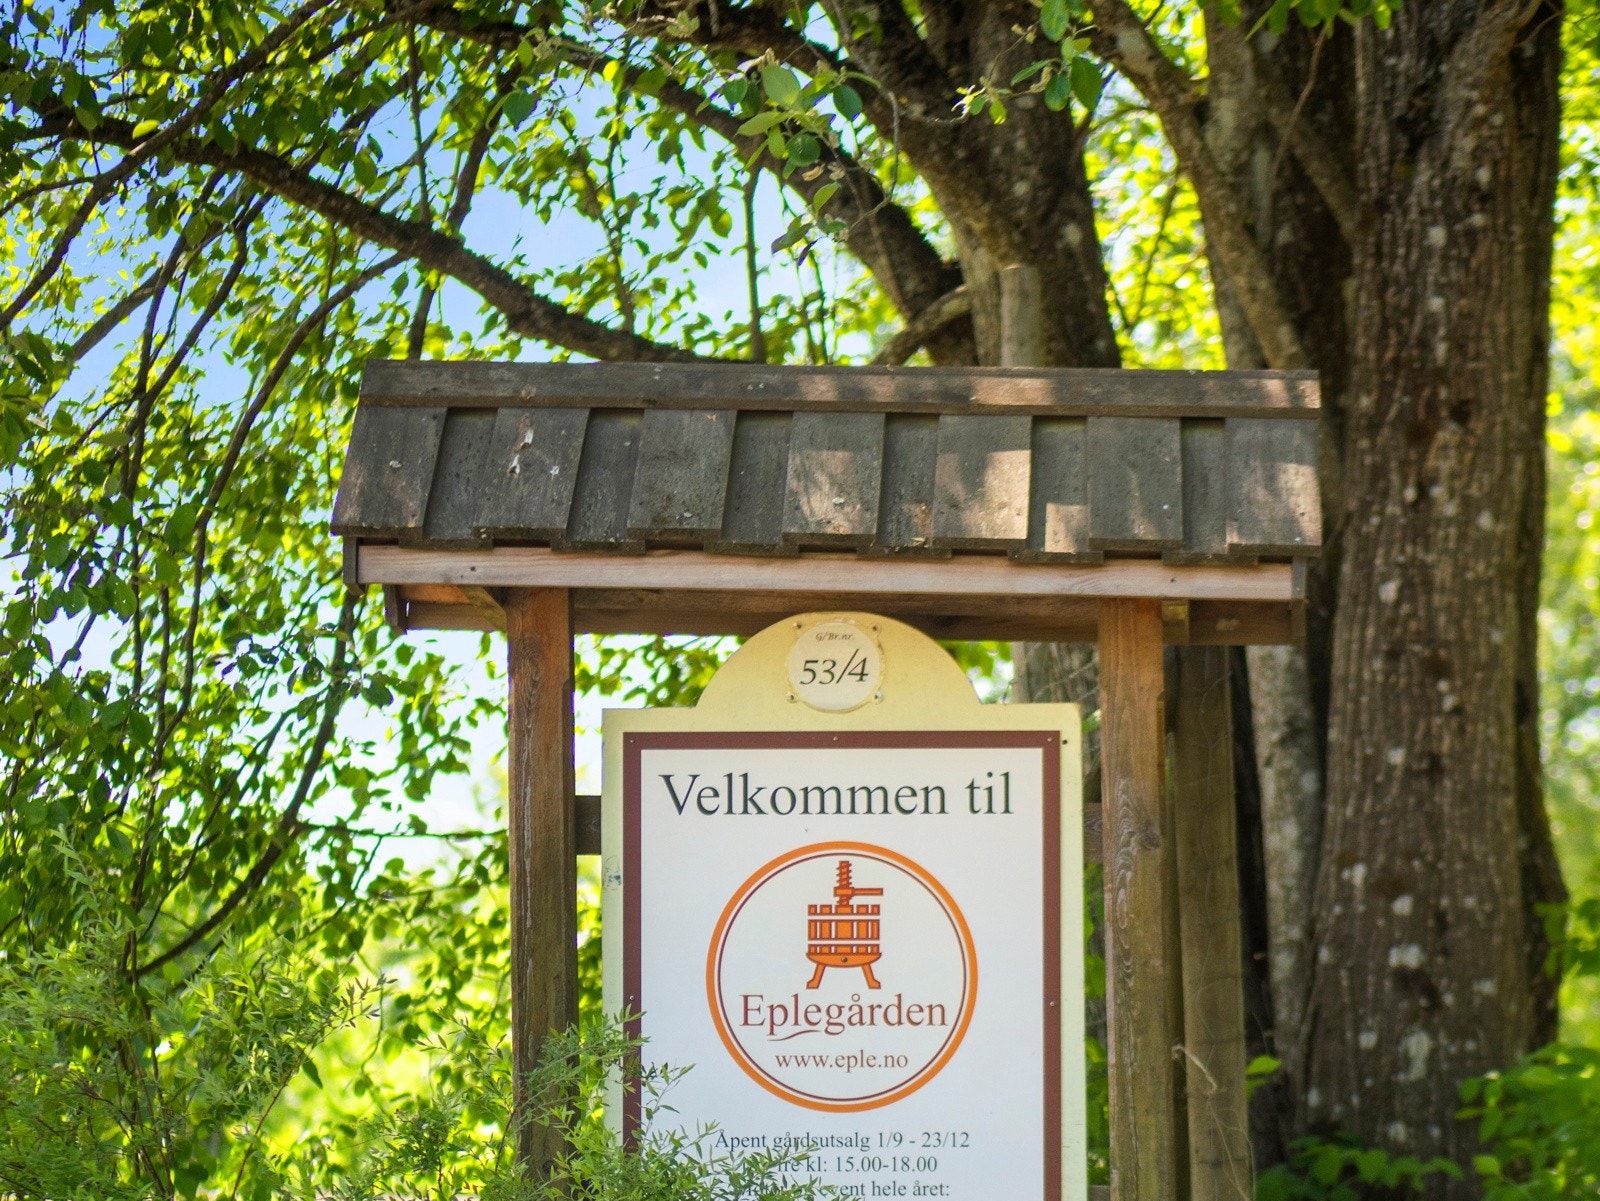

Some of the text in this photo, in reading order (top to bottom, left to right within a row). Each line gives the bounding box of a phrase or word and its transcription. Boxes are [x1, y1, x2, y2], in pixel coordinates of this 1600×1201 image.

[800, 649, 869, 686] 53/4
[658, 771, 1015, 816] Velkommen til
[740, 993, 947, 1036] Eplegården
[776, 1049, 909, 1074] www.eple.no
[715, 1129, 766, 1151] Åpent
[878, 1131, 903, 1148] 1/9
[921, 1131, 970, 1148] 23/12
[835, 1155, 938, 1173] 15.00-18.00
[872, 1180, 907, 1197] hele
[912, 1180, 950, 1197] året:
